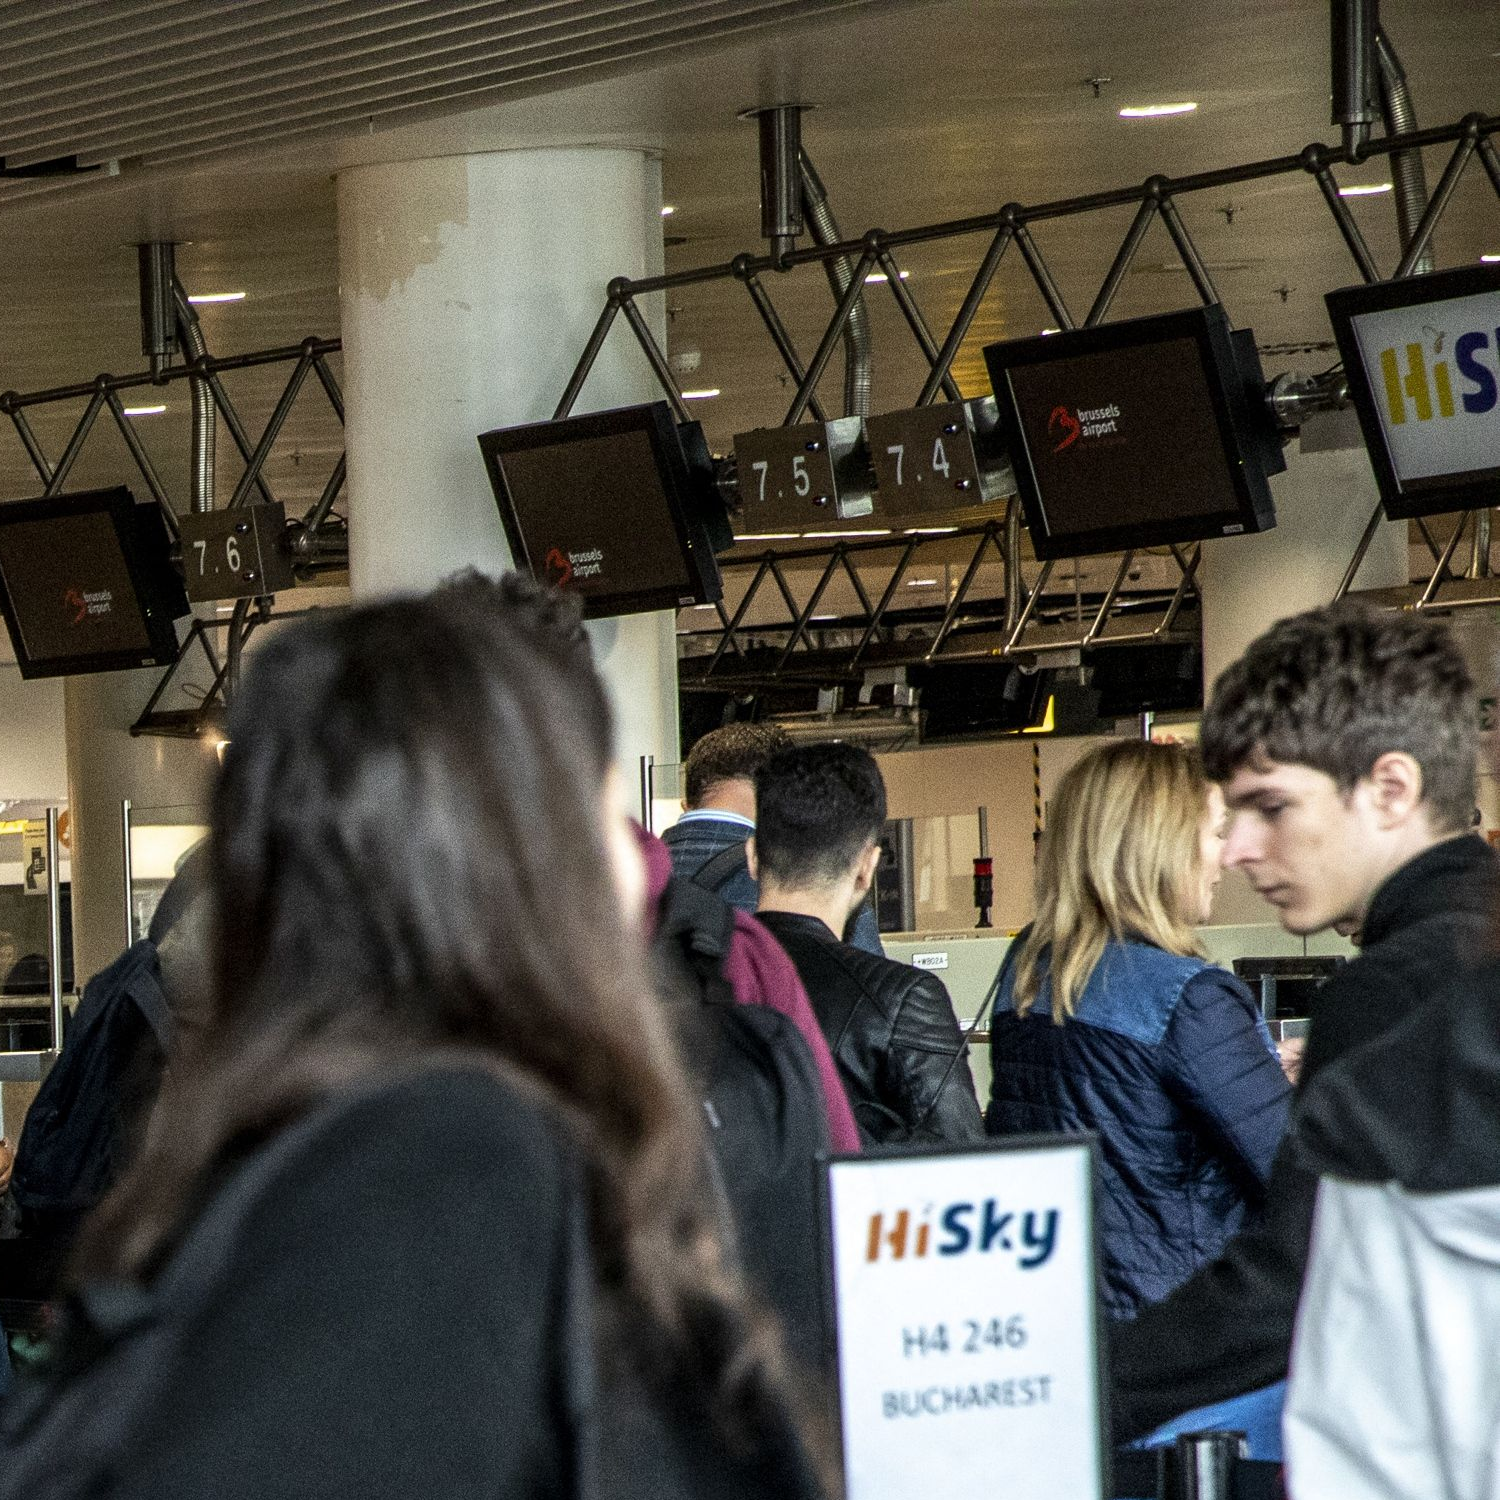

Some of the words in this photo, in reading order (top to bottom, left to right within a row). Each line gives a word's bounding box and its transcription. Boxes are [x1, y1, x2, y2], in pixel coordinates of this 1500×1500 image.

[1380, 325, 1500, 425] HiS
[1077, 403, 1121, 422] brussels
[1081, 419, 1118, 438] airport
[752, 456, 811, 501] 7.5
[887, 437, 950, 485] 7.4
[193, 536, 241, 576] 7.6
[568, 548, 604, 564] brussels
[573, 562, 602, 578] airport
[866, 1198, 1060, 1271] HiSky
[901, 1322, 950, 1359] H4
[962, 1312, 1028, 1355] 246
[881, 1373, 1052, 1420] BUCHAREST
